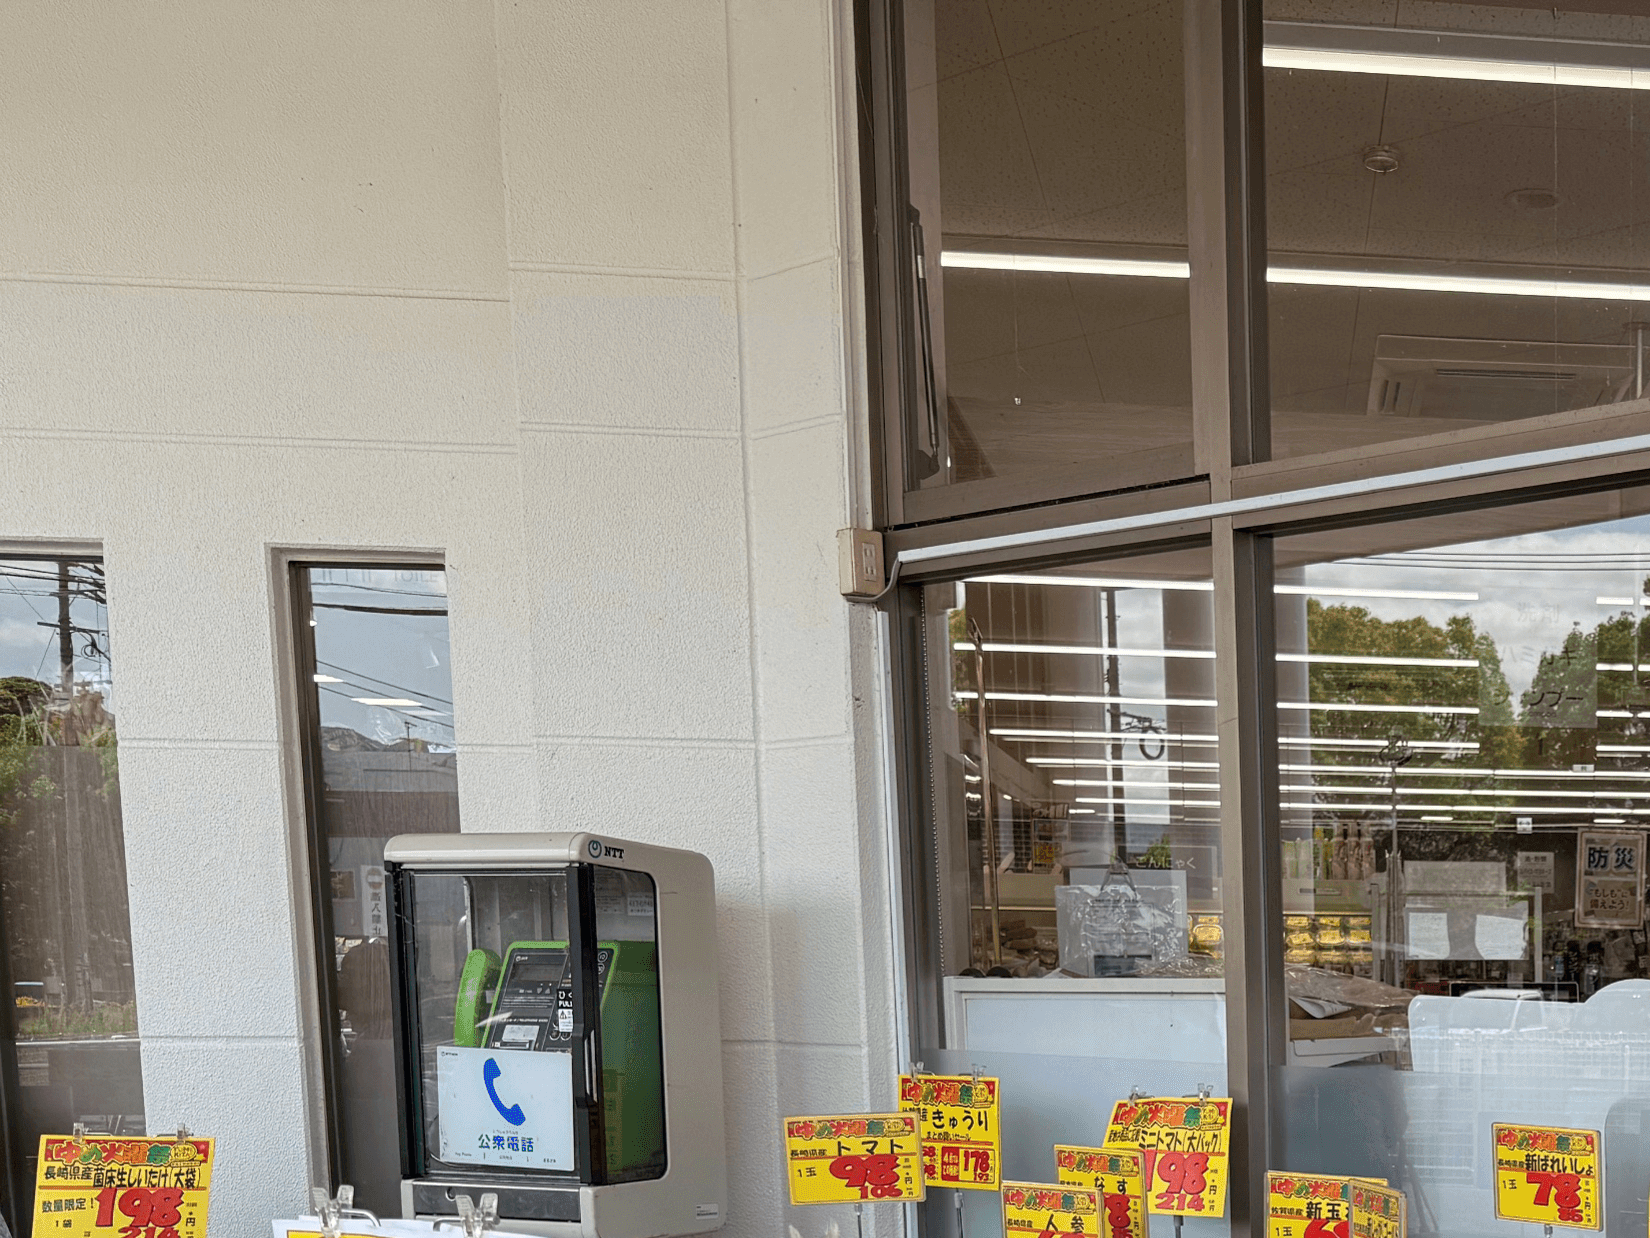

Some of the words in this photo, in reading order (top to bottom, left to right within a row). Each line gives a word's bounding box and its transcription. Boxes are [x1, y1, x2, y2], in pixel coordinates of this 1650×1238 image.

[604, 845, 625, 860] NTT
[1136, 856, 1196, 869] こんにゃく
[1587, 843, 1634, 870] 防災
[932, 1108, 989, 1131] きゅうり
[478, 1133, 534, 1153] 公衆電話
[837, 1139, 904, 1156] トマト
[829, 1154, 900, 1187] 98
[964, 1150, 990, 1173] 178
[1525, 1153, 1594, 1177] 新ばれいしょ
[44, 1166, 92, 1180] 長崎県産
[797, 1166, 817, 1178] 1玉
[1144, 1150, 1209, 1195] 198
[1094, 1176, 1128, 1195] なす
[1526, 1171, 1582, 1209] 78
[95, 1187, 184, 1227] 198
[1103, 1194, 1131, 1228] 8
[1155, 1193, 1205, 1211] 214
[1306, 1201, 1349, 1222] 新玉
[185, 1217, 196, 1227] 円
[1045, 1213, 1084, 1233] 人参
[1275, 1226, 1293, 1237] 1玉
